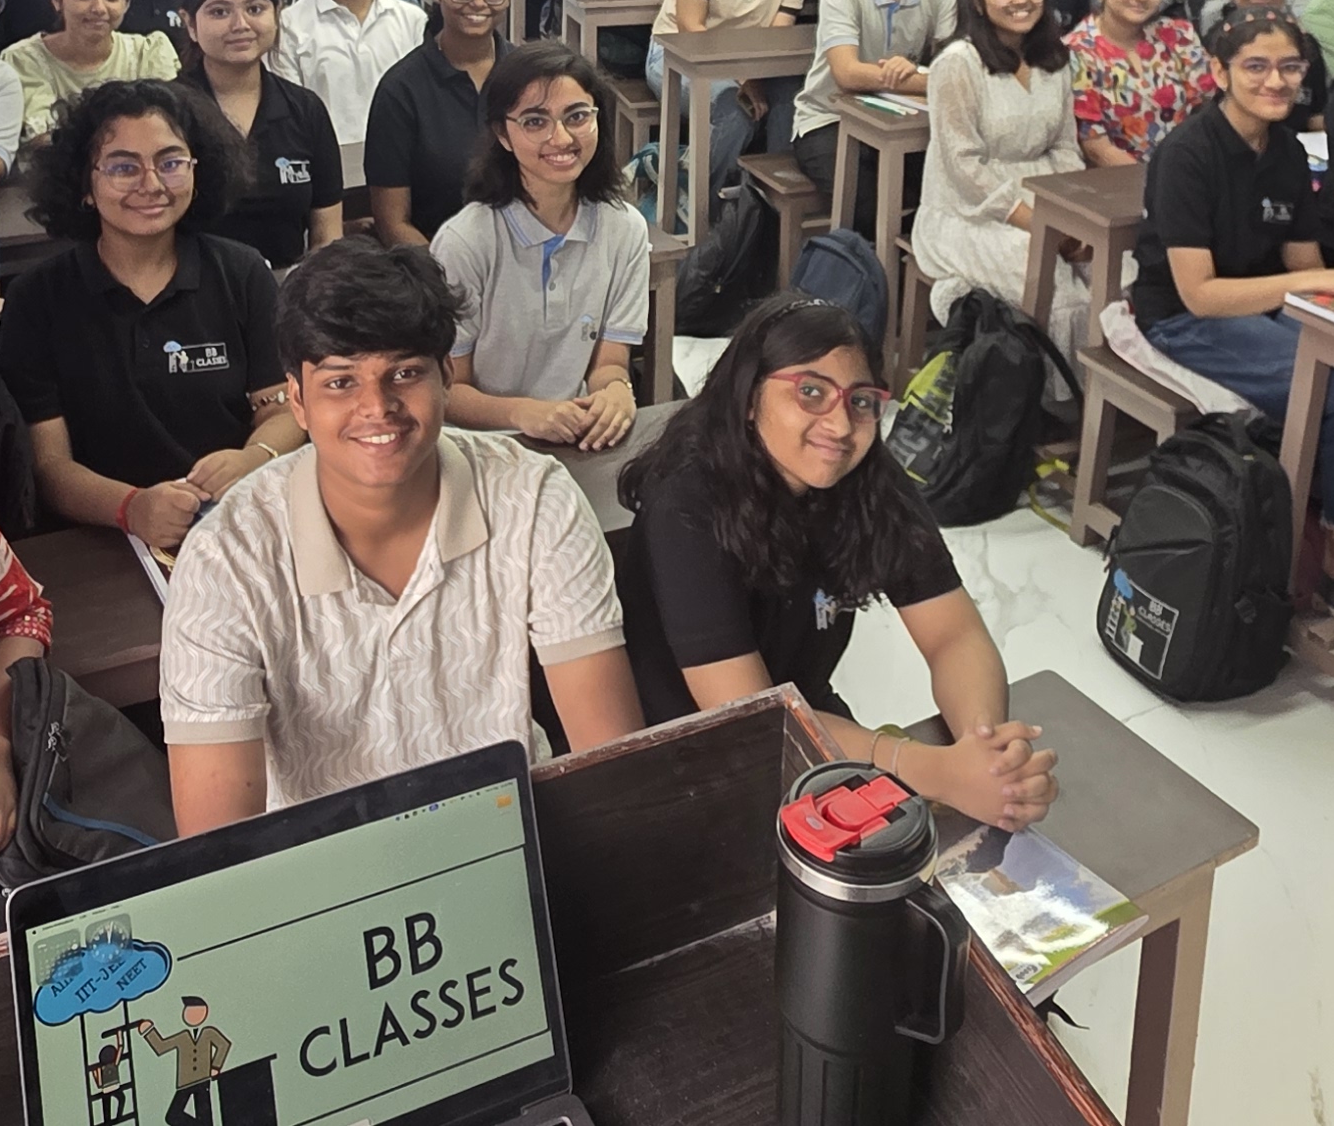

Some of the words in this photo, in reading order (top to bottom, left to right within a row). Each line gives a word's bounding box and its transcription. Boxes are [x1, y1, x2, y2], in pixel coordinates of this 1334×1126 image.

[116, 957, 147, 992] NEET
[363, 912, 443, 991] BB
[299, 958, 525, 1077] CLASSES
